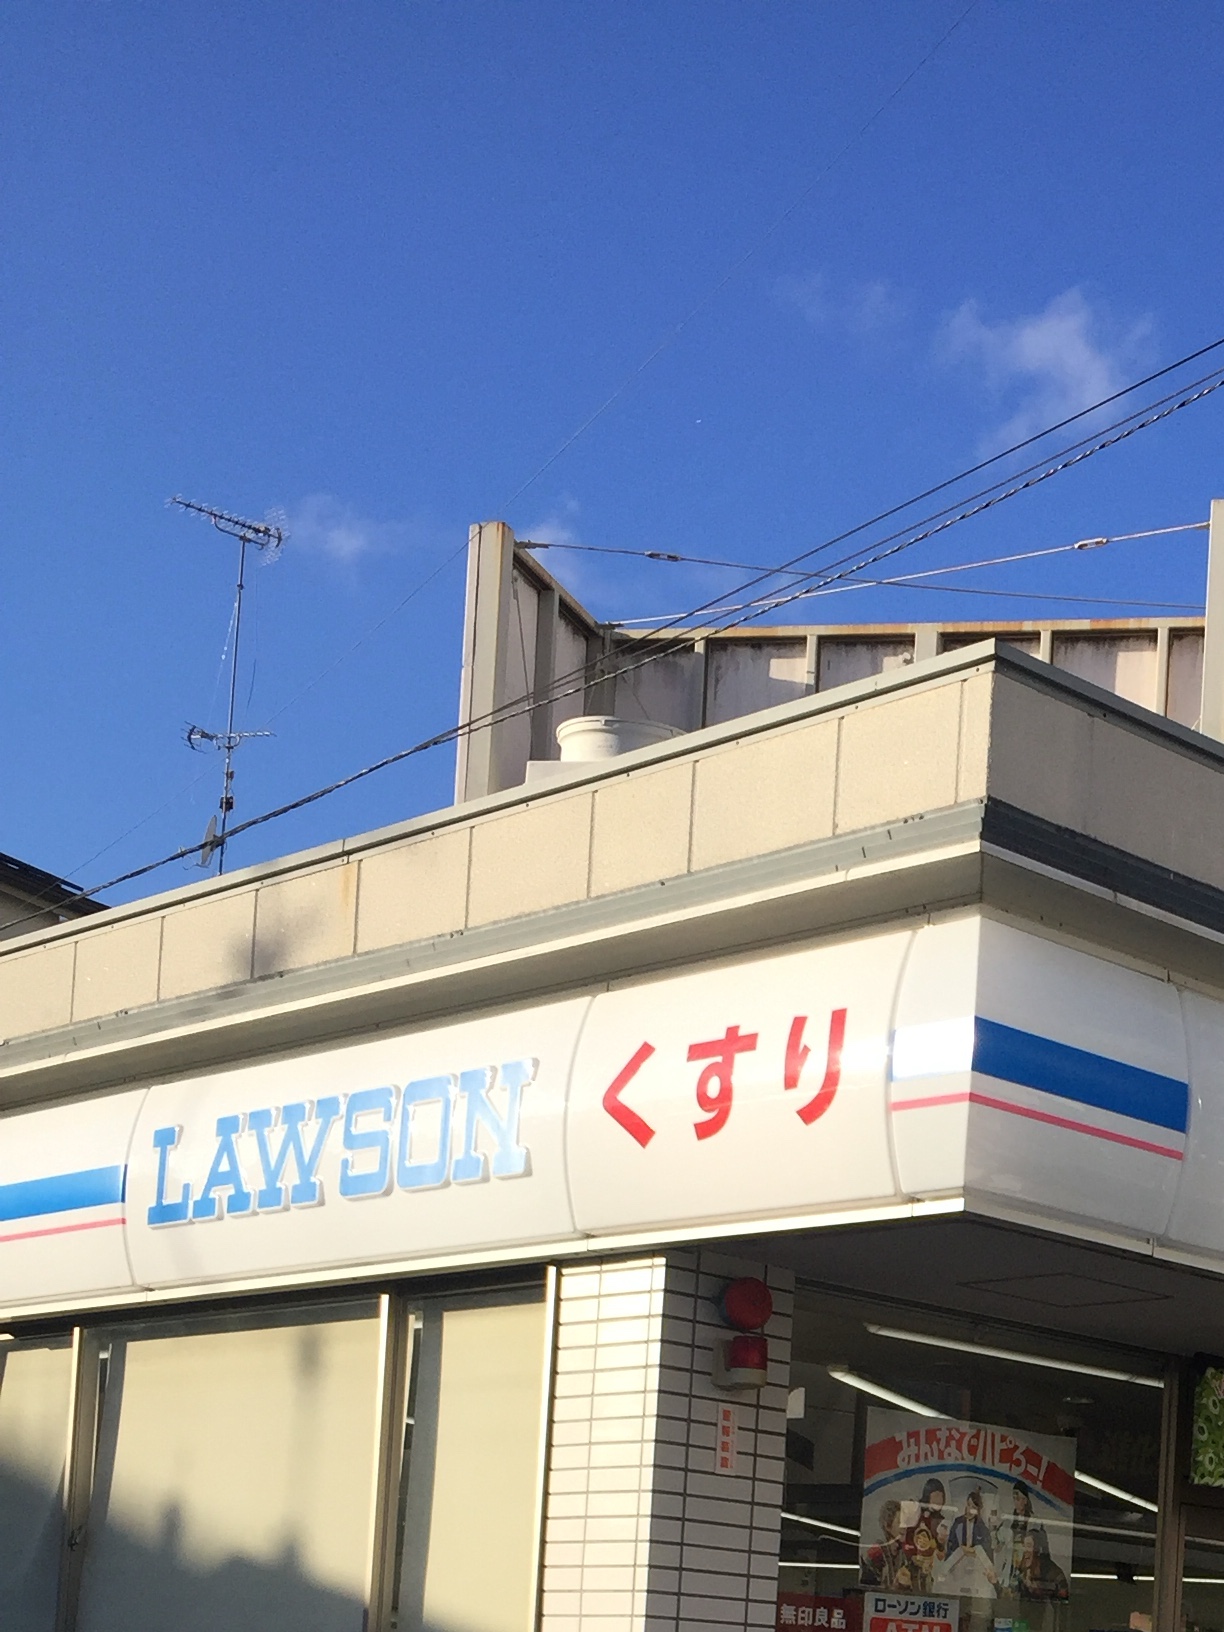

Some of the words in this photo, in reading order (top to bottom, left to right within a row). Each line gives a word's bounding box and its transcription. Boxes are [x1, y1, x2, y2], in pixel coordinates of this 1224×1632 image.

[602, 1007, 848, 1149] くすり
[147, 1058, 537, 1228] LAWSON
[780, 1603, 847, 1630] 無印良品
[874, 1598, 949, 1619] ローソン銀行
